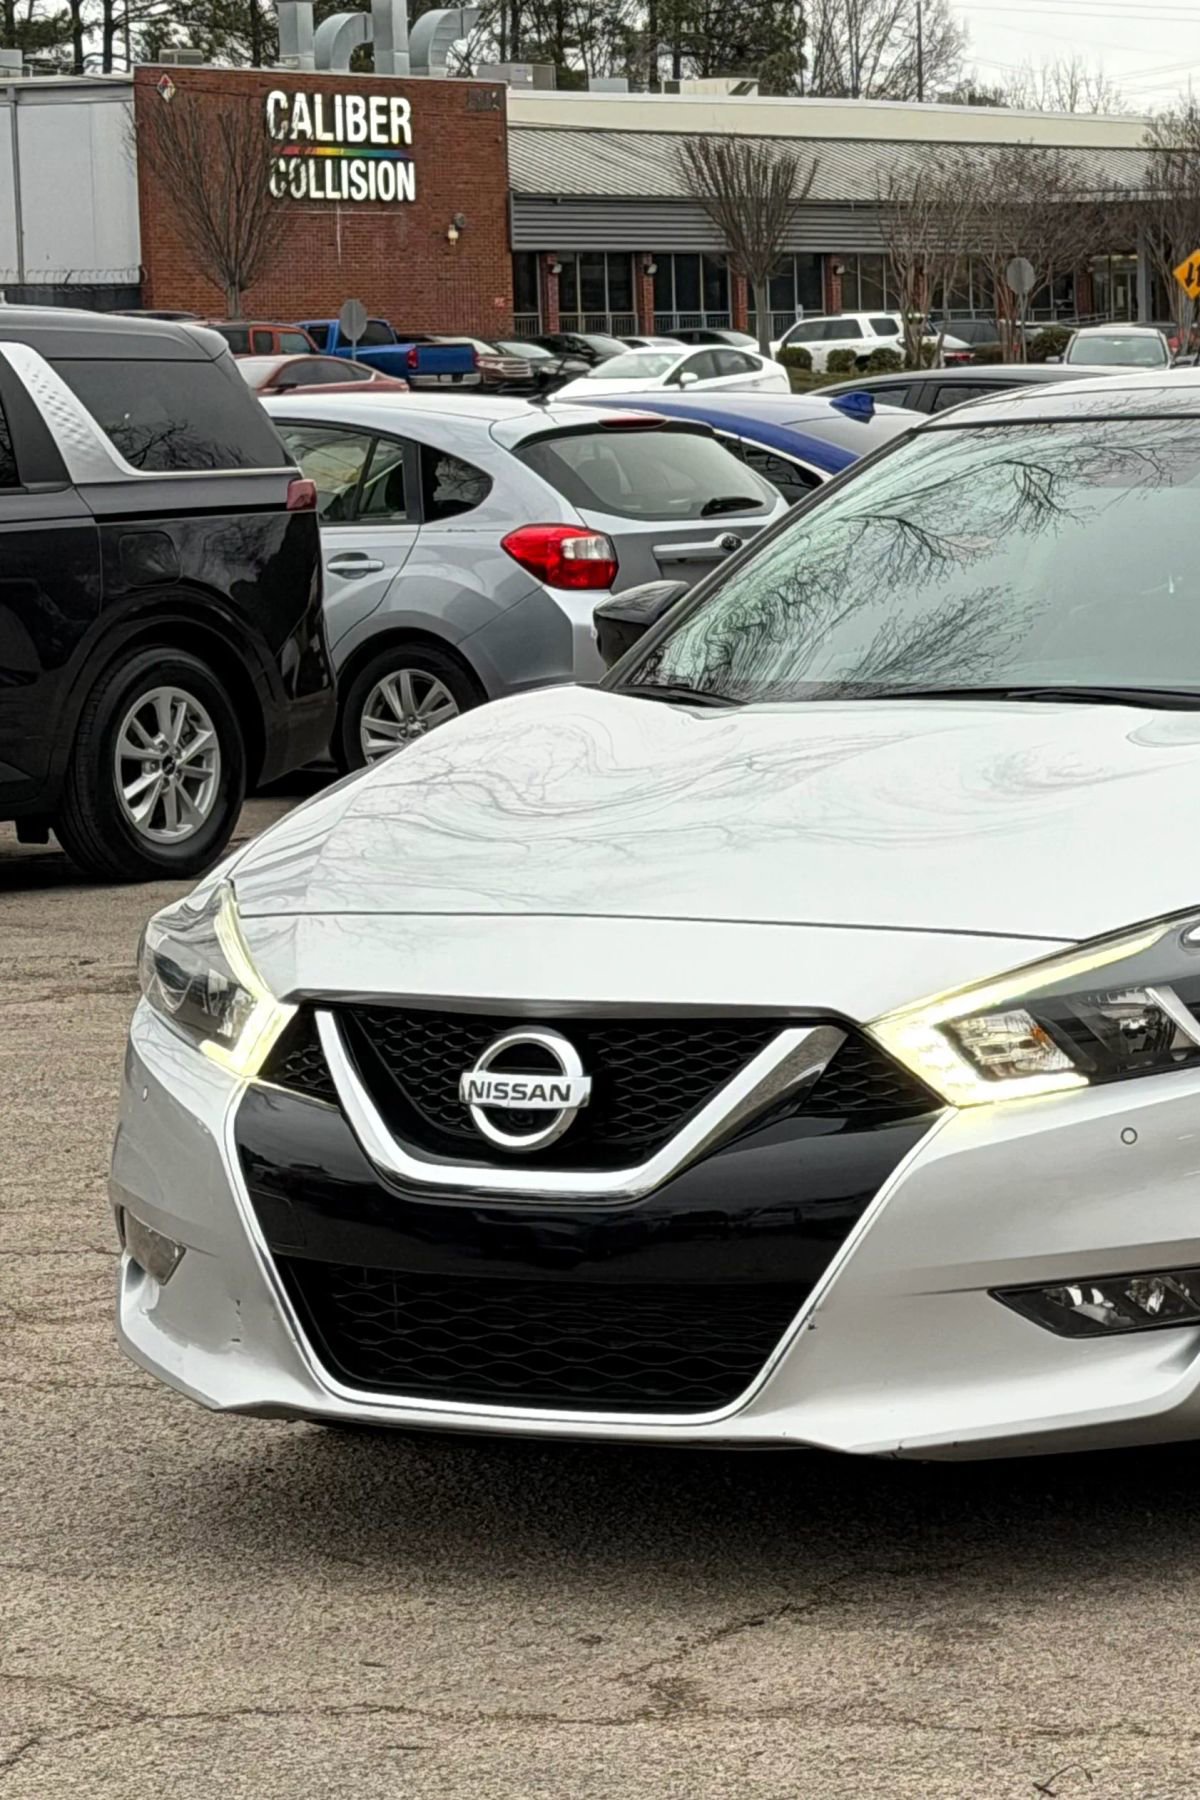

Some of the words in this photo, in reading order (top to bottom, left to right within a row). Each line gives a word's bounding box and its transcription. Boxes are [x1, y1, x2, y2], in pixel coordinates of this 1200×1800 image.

[266, 90, 412, 144] CALIBER
[269, 157, 415, 201] COLLISION
[468, 1080, 571, 1102] NISSAN
